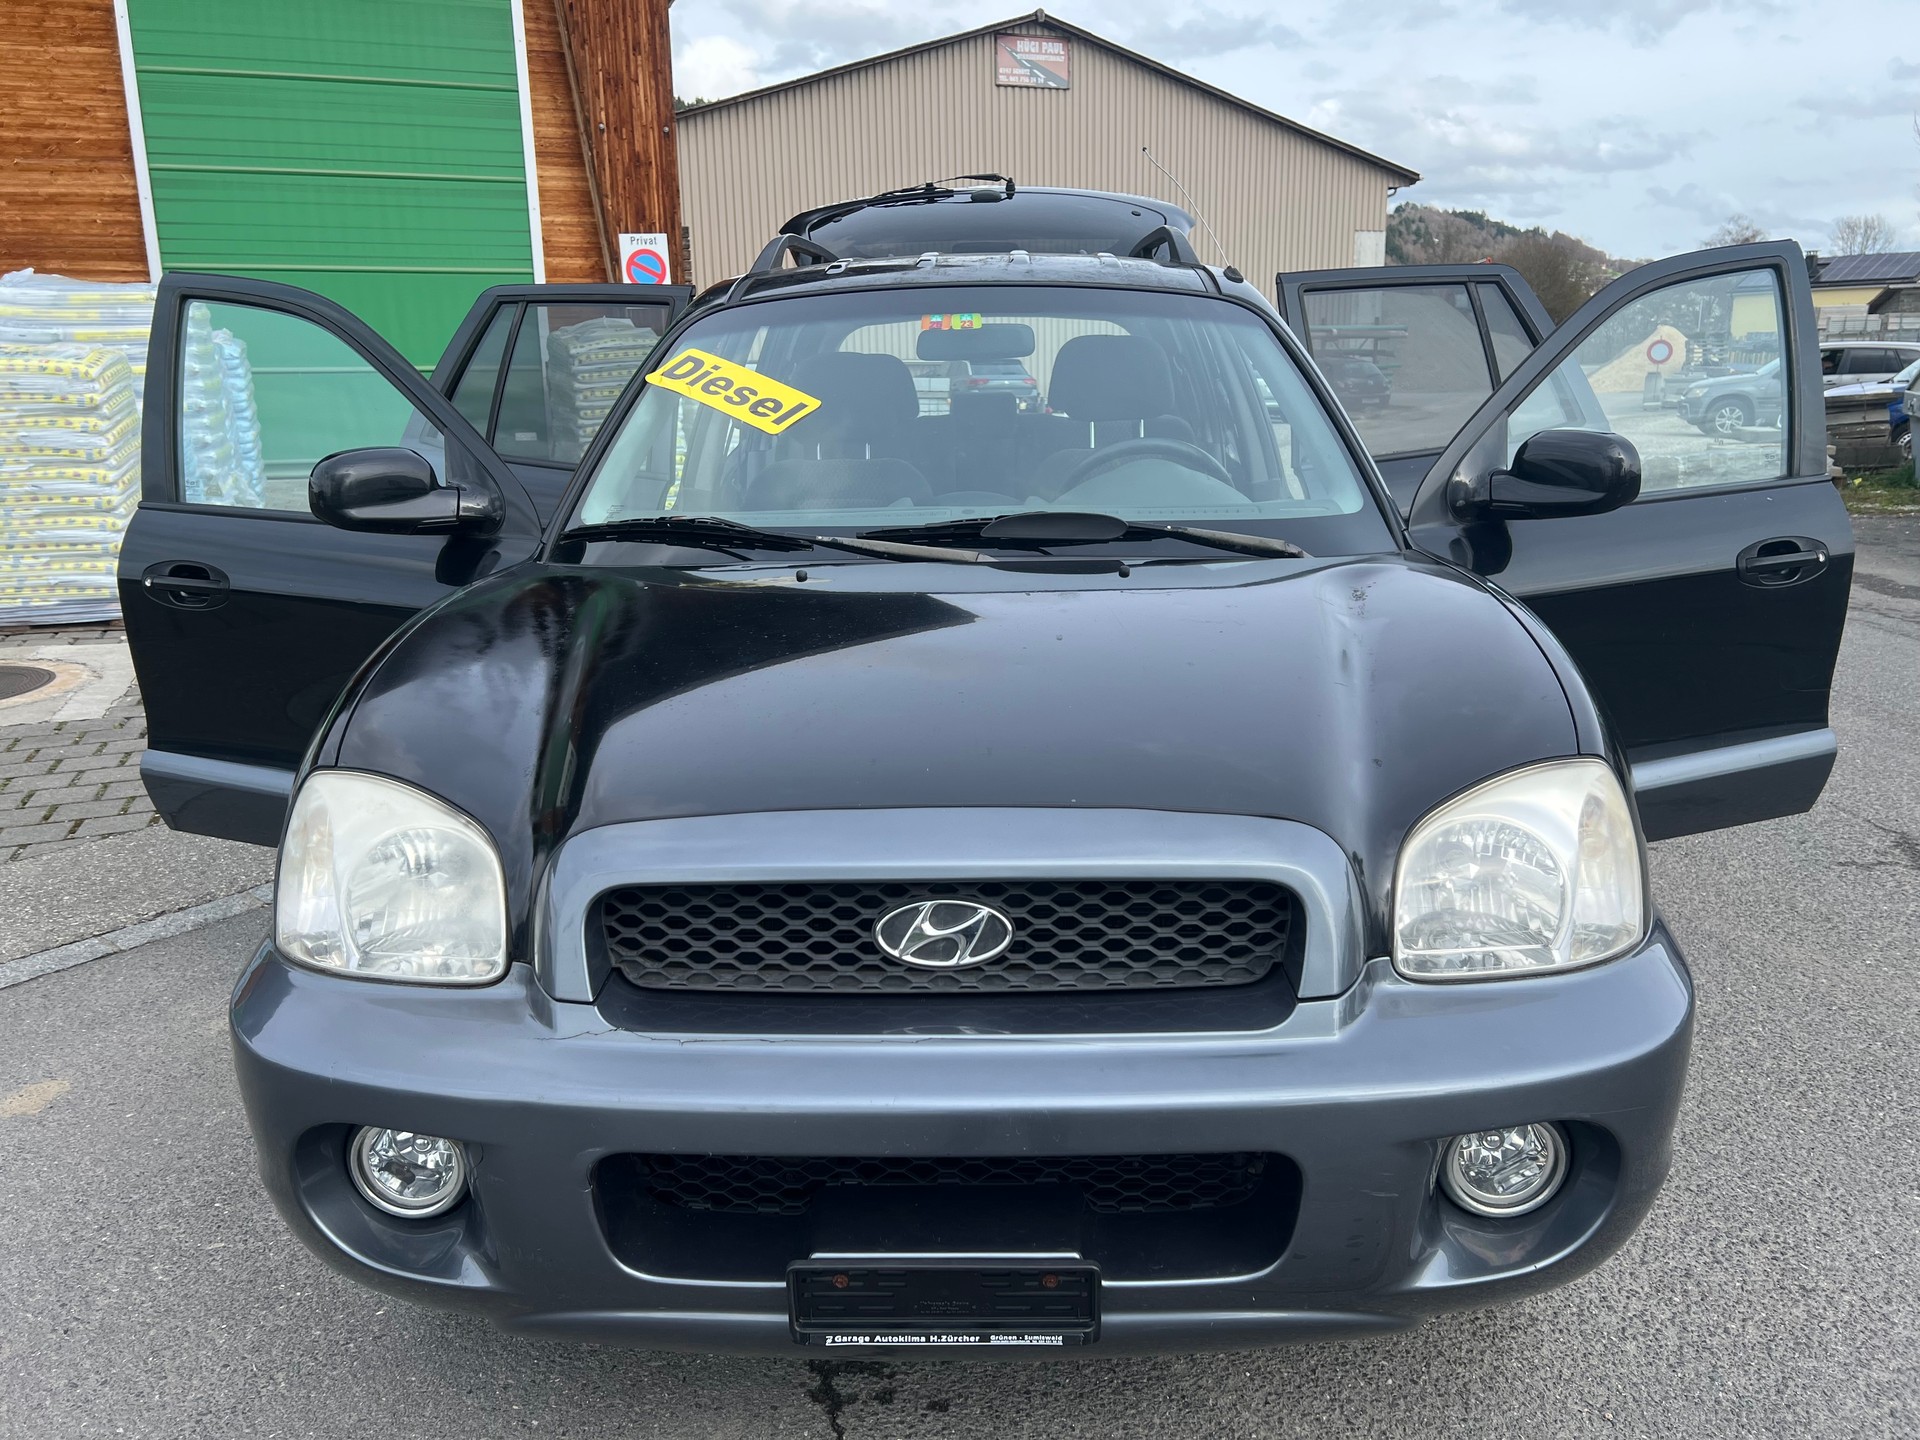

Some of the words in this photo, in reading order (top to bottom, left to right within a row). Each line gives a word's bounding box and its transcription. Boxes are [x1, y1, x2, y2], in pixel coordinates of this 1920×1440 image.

[1041, 41, 1065, 55] PAUL
[630, 236, 658, 246] Privat
[960, 320, 974, 328] 23
[661, 355, 809, 426] Diesel
[834, 1335, 871, 1344] Garage
[874, 1335, 926, 1343] Autoklima
[930, 1334, 980, 1343] H.Zürcher
